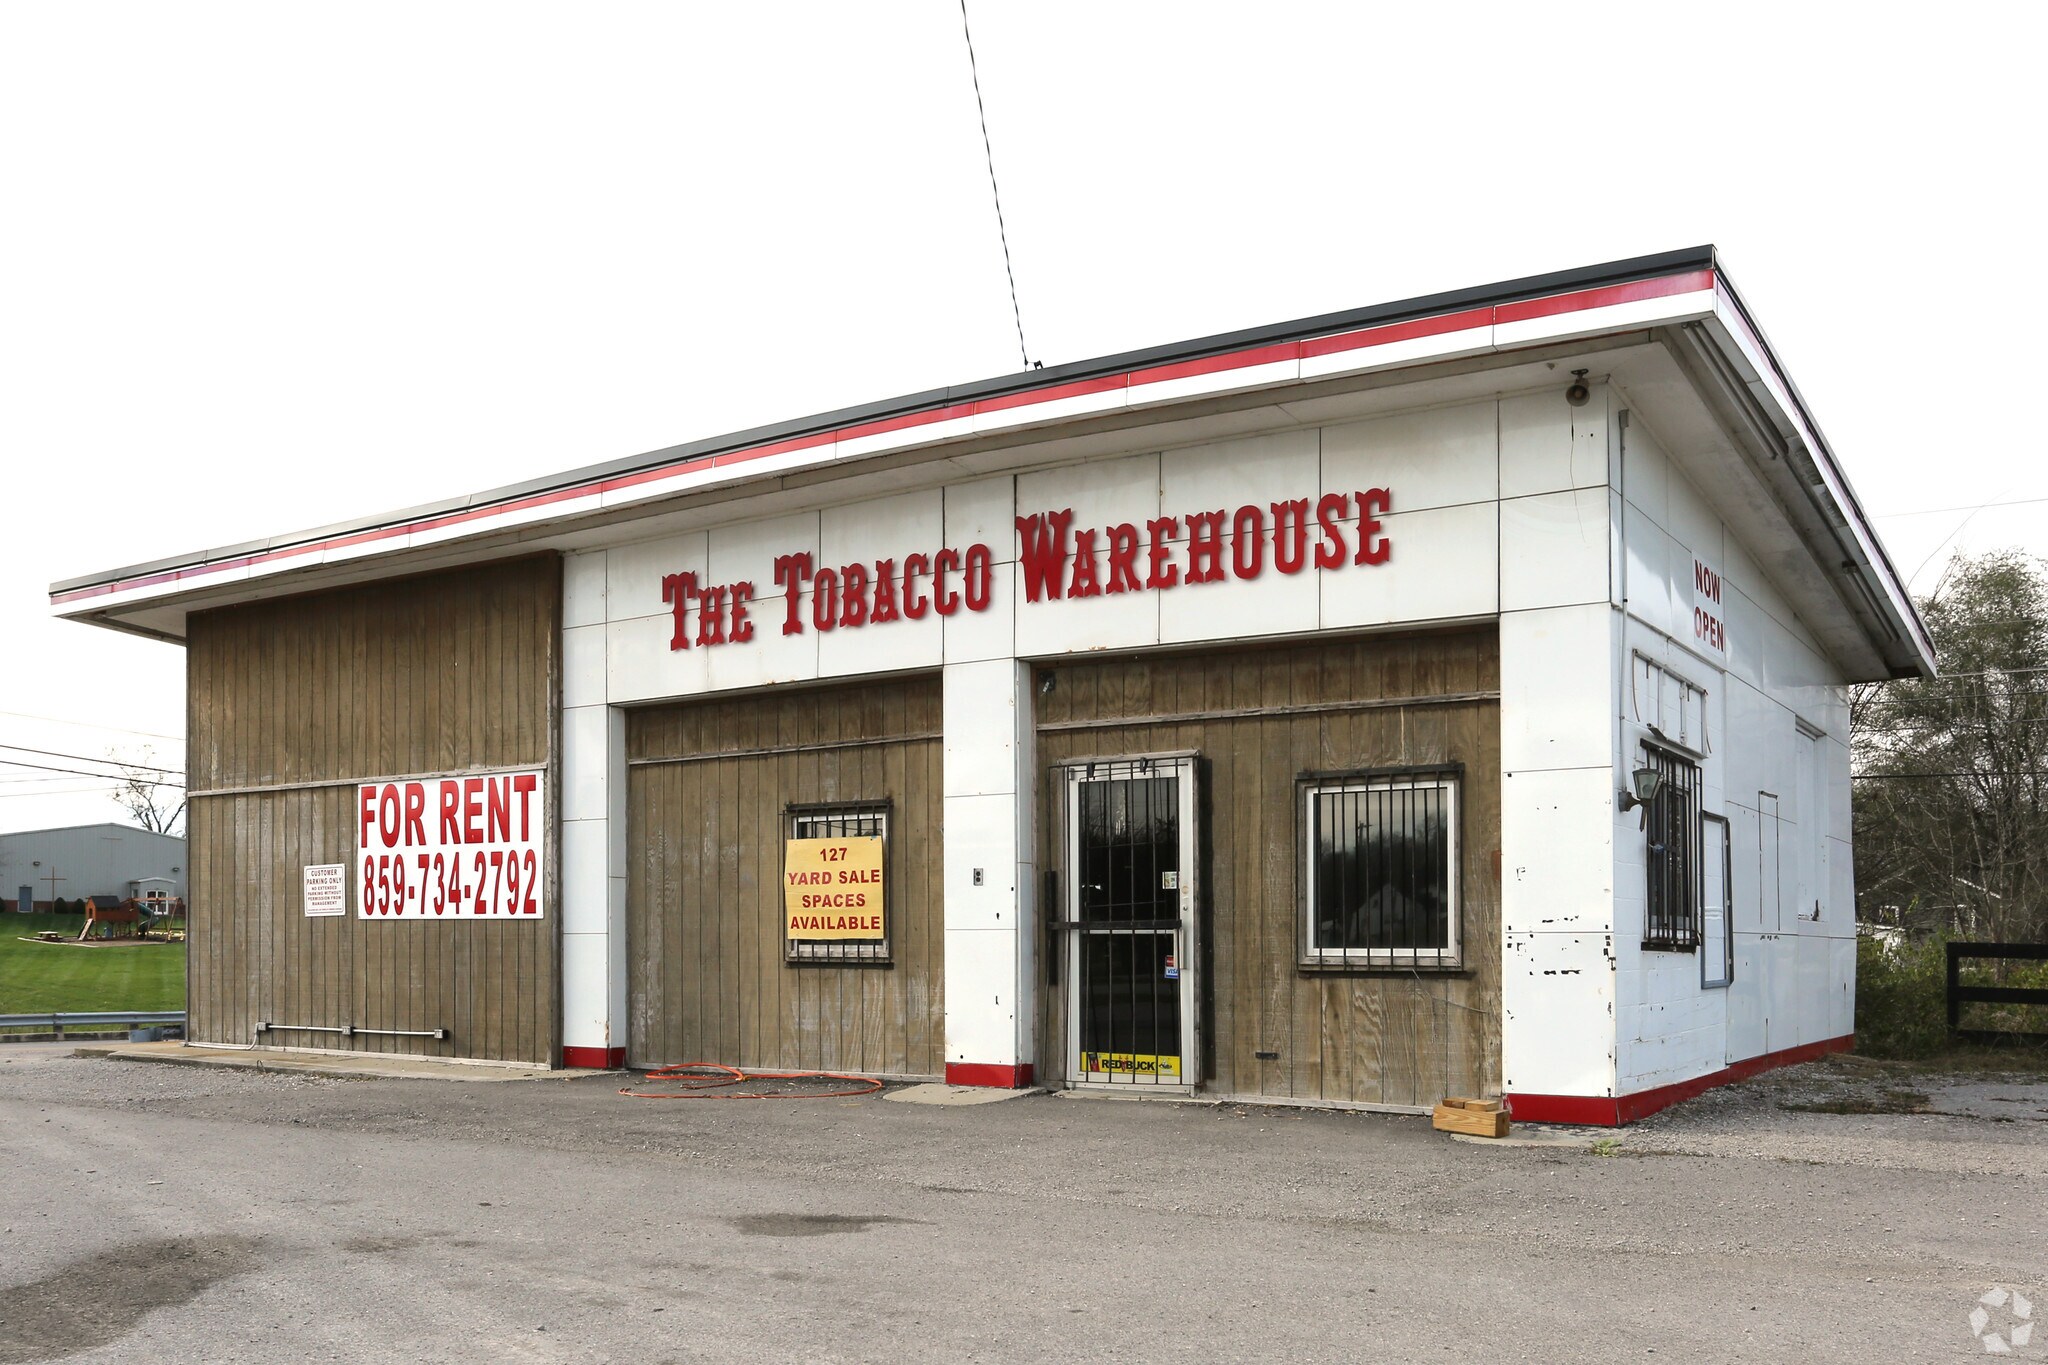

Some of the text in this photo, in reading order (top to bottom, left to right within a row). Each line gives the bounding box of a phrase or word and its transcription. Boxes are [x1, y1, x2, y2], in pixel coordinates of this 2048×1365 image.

[774, 543, 992, 635] TOBACCO
[1016, 487, 1390, 603] WAREHOUSE
[1695, 559, 1720, 605] NOW
[1694, 606, 1724, 652] OPEN
[361, 775, 536, 848] FOR RENT
[820, 847, 848, 862] 127
[306, 877, 328, 885] PARKING
[311, 869, 338, 877] CUSTOMER
[788, 869, 880, 885] YARD SALE
[364, 849, 537, 915] 859-734-2792
[802, 893, 866, 908] SPACES
[790, 916, 880, 930] AVAILABLE
